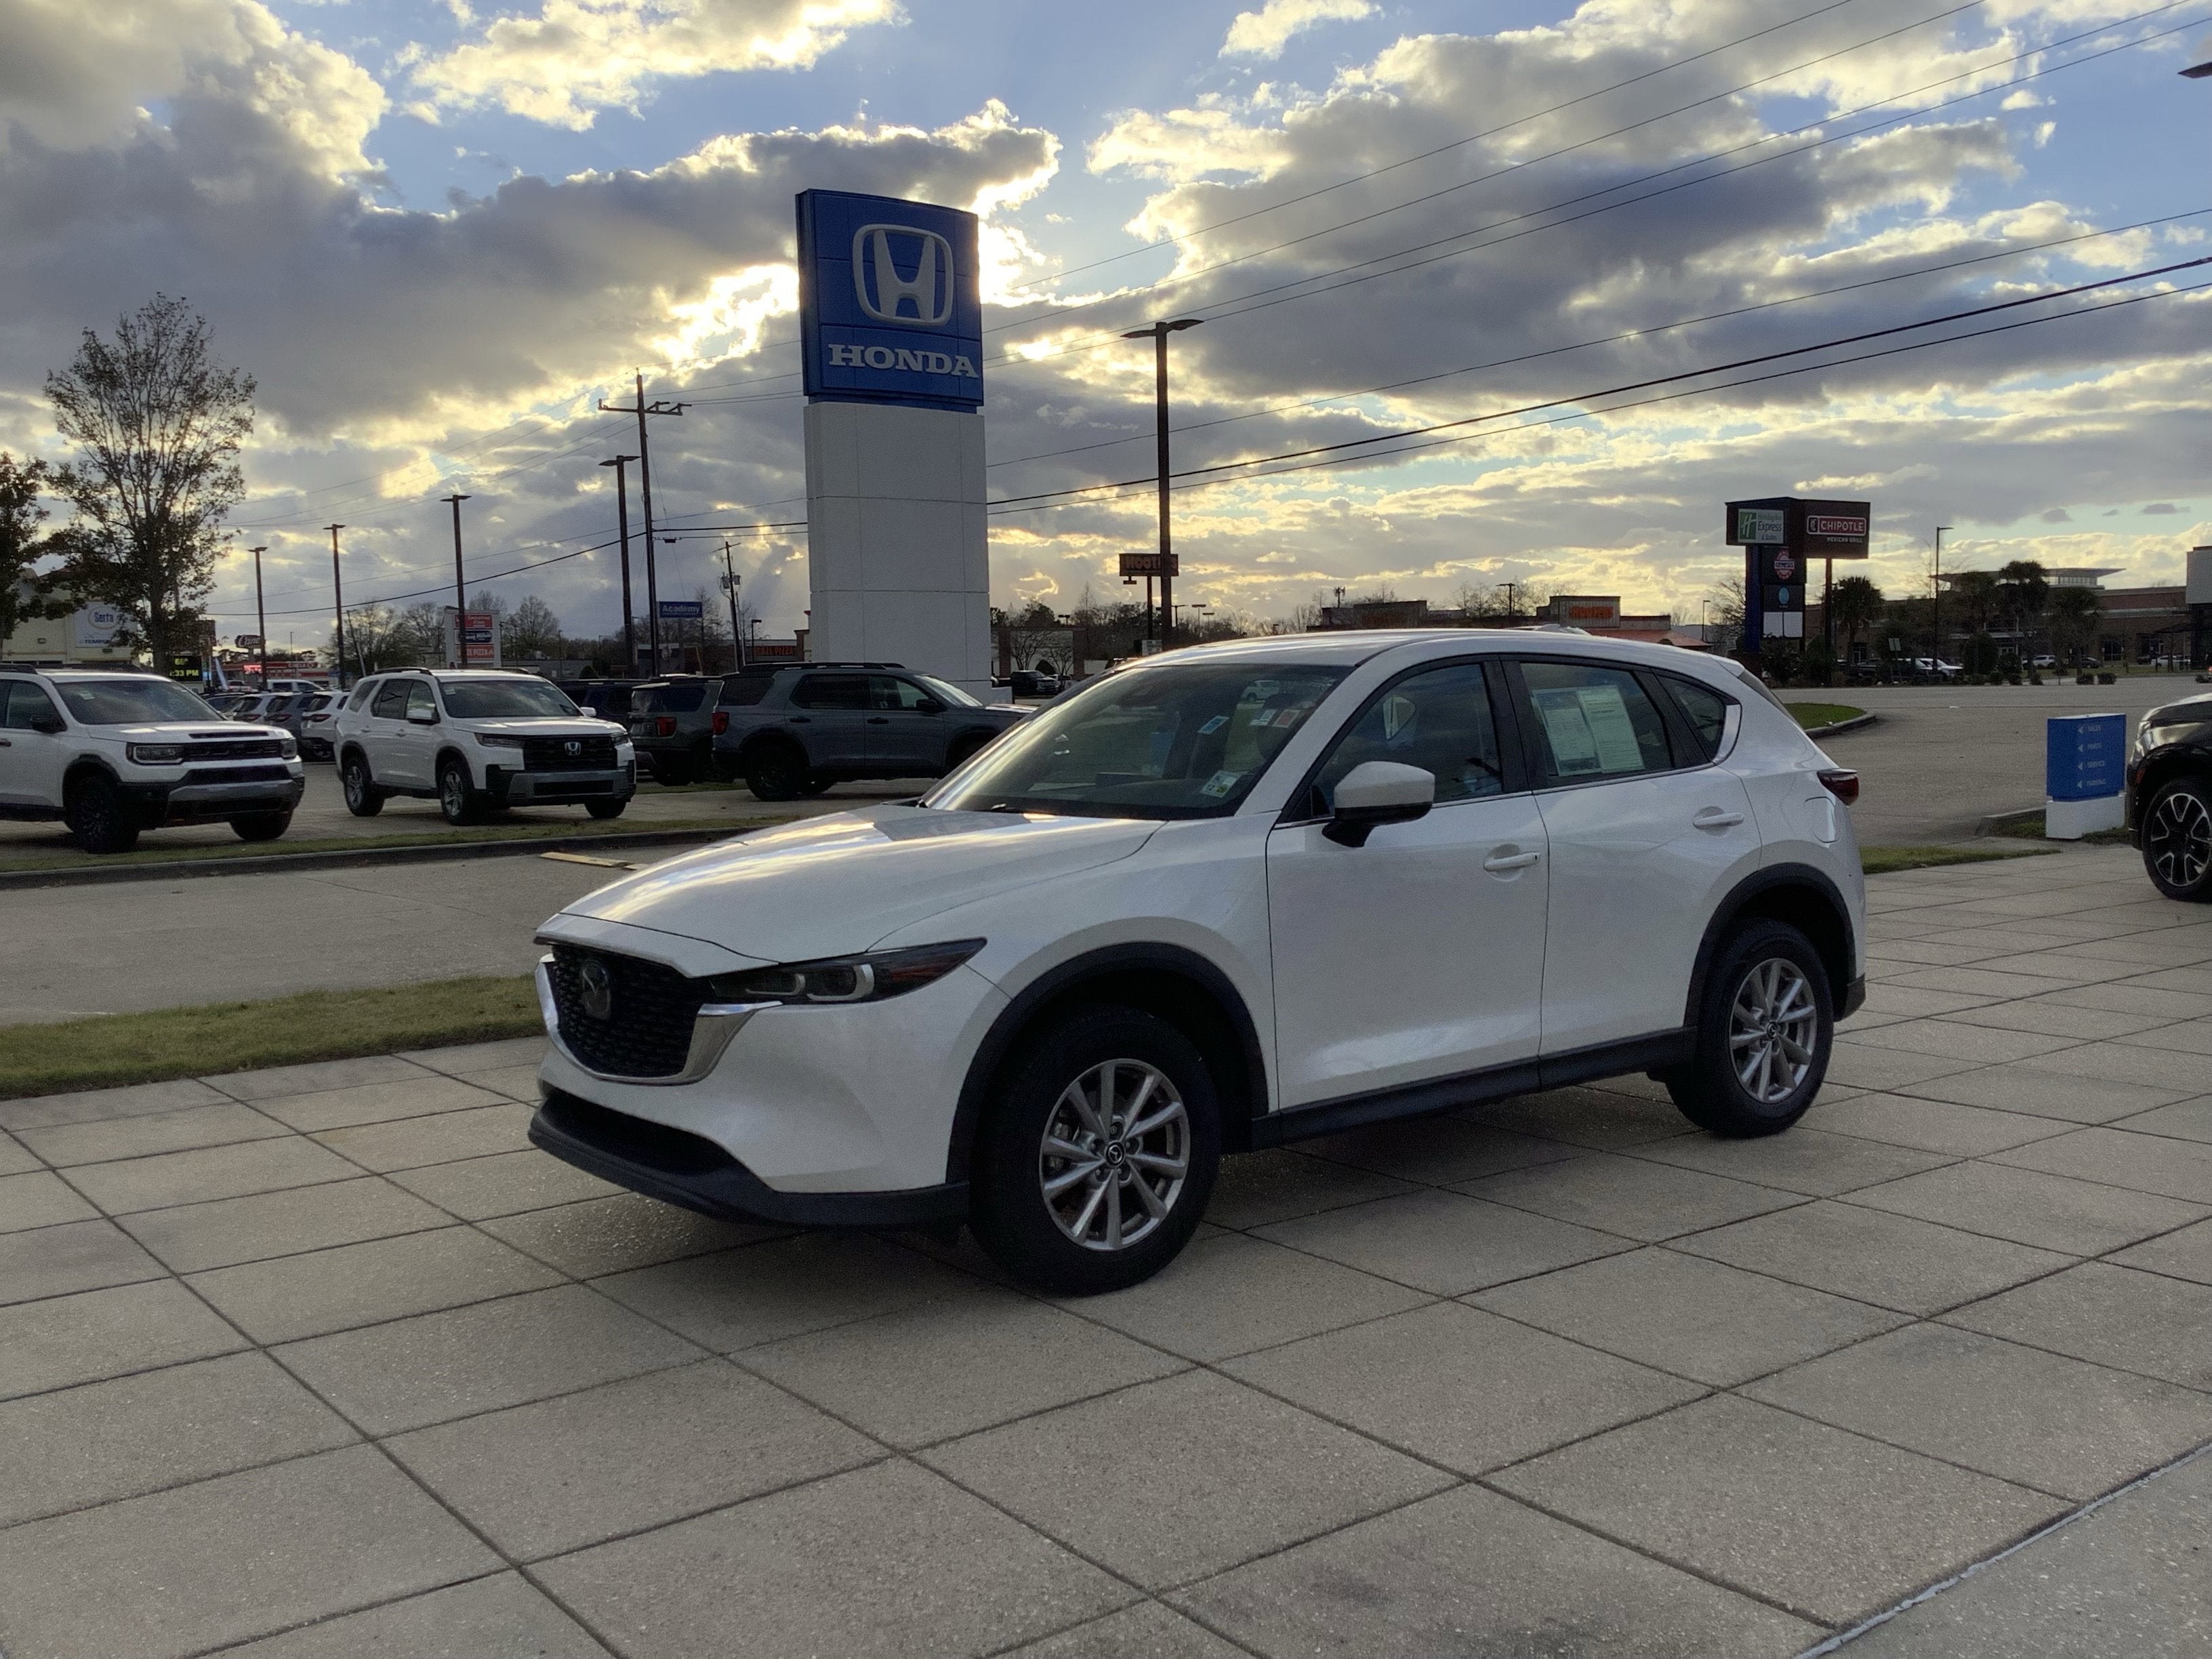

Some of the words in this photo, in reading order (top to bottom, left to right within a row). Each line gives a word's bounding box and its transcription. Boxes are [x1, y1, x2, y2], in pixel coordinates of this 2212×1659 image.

[827, 344, 979, 378] HONDA
[1758, 520, 1782, 533] Express
[1821, 520, 1864, 531] CHIPOTLE
[662, 605, 699, 615] Academy
[94, 612, 114, 623] Serta
